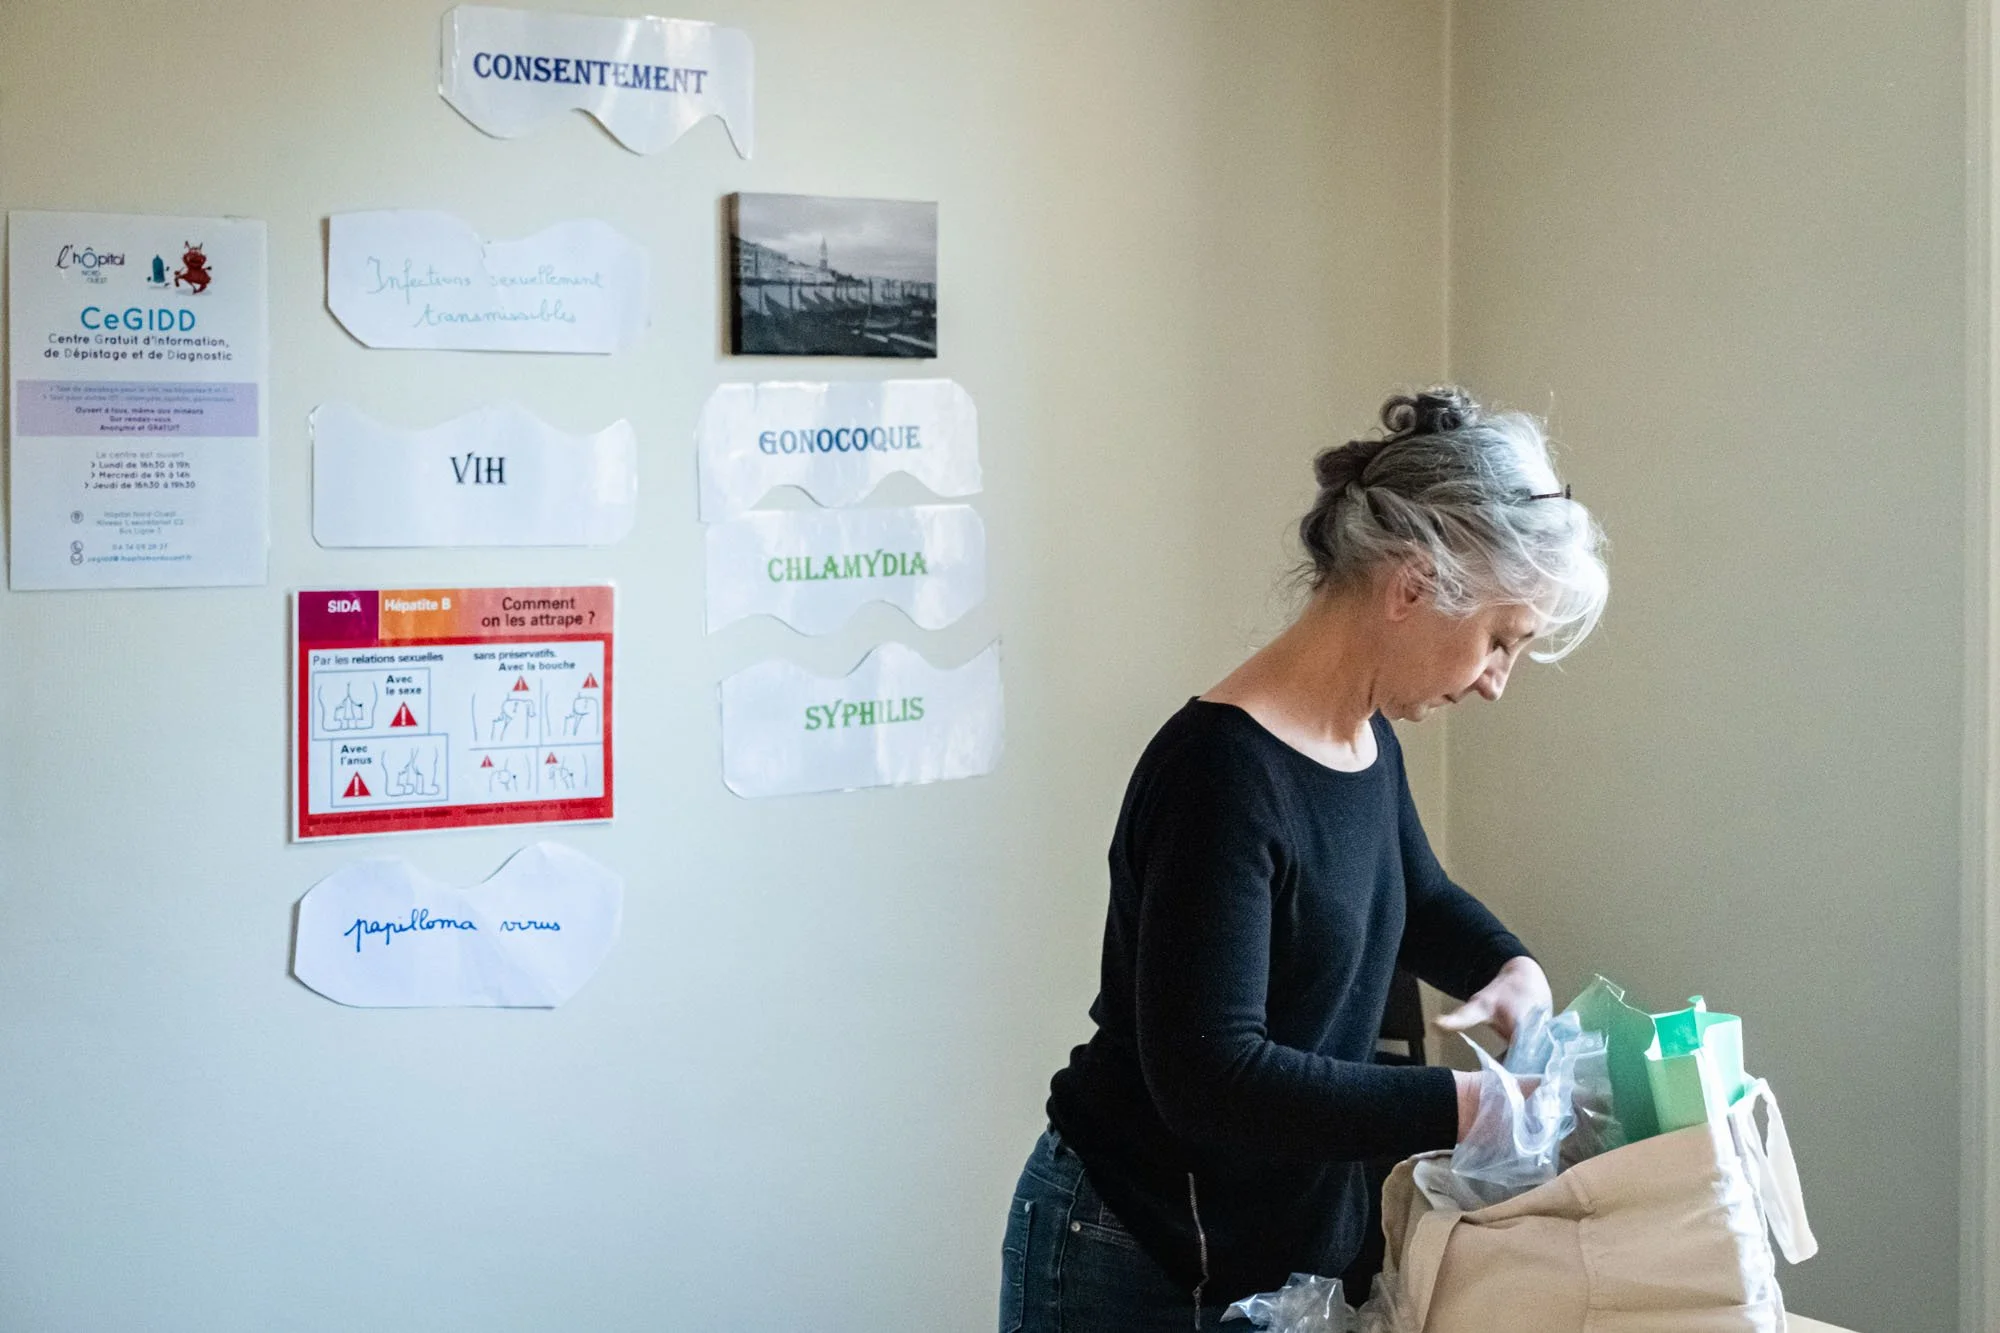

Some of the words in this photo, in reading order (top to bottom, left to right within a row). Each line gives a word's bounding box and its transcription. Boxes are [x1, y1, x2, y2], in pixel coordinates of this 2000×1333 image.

[473, 52, 708, 94] CONSENTEMENT
[80, 306, 196, 332] CeGIDD
[413, 299, 577, 328] transmissibles
[49, 333, 90, 345] Centre
[95, 334, 138, 345] Gratuit
[44, 349, 60, 358] de
[65, 349, 127, 361] Dépistage
[132, 351, 143, 360] et
[148, 351, 163, 360] de
[168, 350, 232, 362] Diagnostic
[758, 426, 922, 455] GONOCOQUE
[99, 461, 123, 469] Lundi
[449, 451, 507, 485] VIH
[92, 481, 118, 489] Jeudi
[767, 549, 928, 582] CHLAMYDIA
[327, 599, 362, 613] SIDA
[384, 598, 438, 613] Hépatite
[441, 597, 451, 610] B
[502, 596, 576, 611] Comment
[481, 616, 500, 627] on
[505, 614, 526, 626] les
[530, 613, 583, 628] attrape
[588, 611, 596, 625] ?
[313, 655, 331, 666] Par
[335, 655, 349, 665] les
[352, 654, 395, 664] relations
[398, 652, 444, 663] sexuelles
[474, 652, 496, 660] sans
[498, 663, 524, 671] Avec
[527, 662, 535, 671] la
[540, 660, 575, 670] bouche
[386, 675, 413, 684] Avec
[386, 687, 395, 695] le
[398, 687, 422, 695] sexe
[804, 697, 925, 731] SYPHILIS
[341, 744, 368, 754] Avec
[344, 909, 477, 952] papilloma
[500, 918, 561, 931] virus
